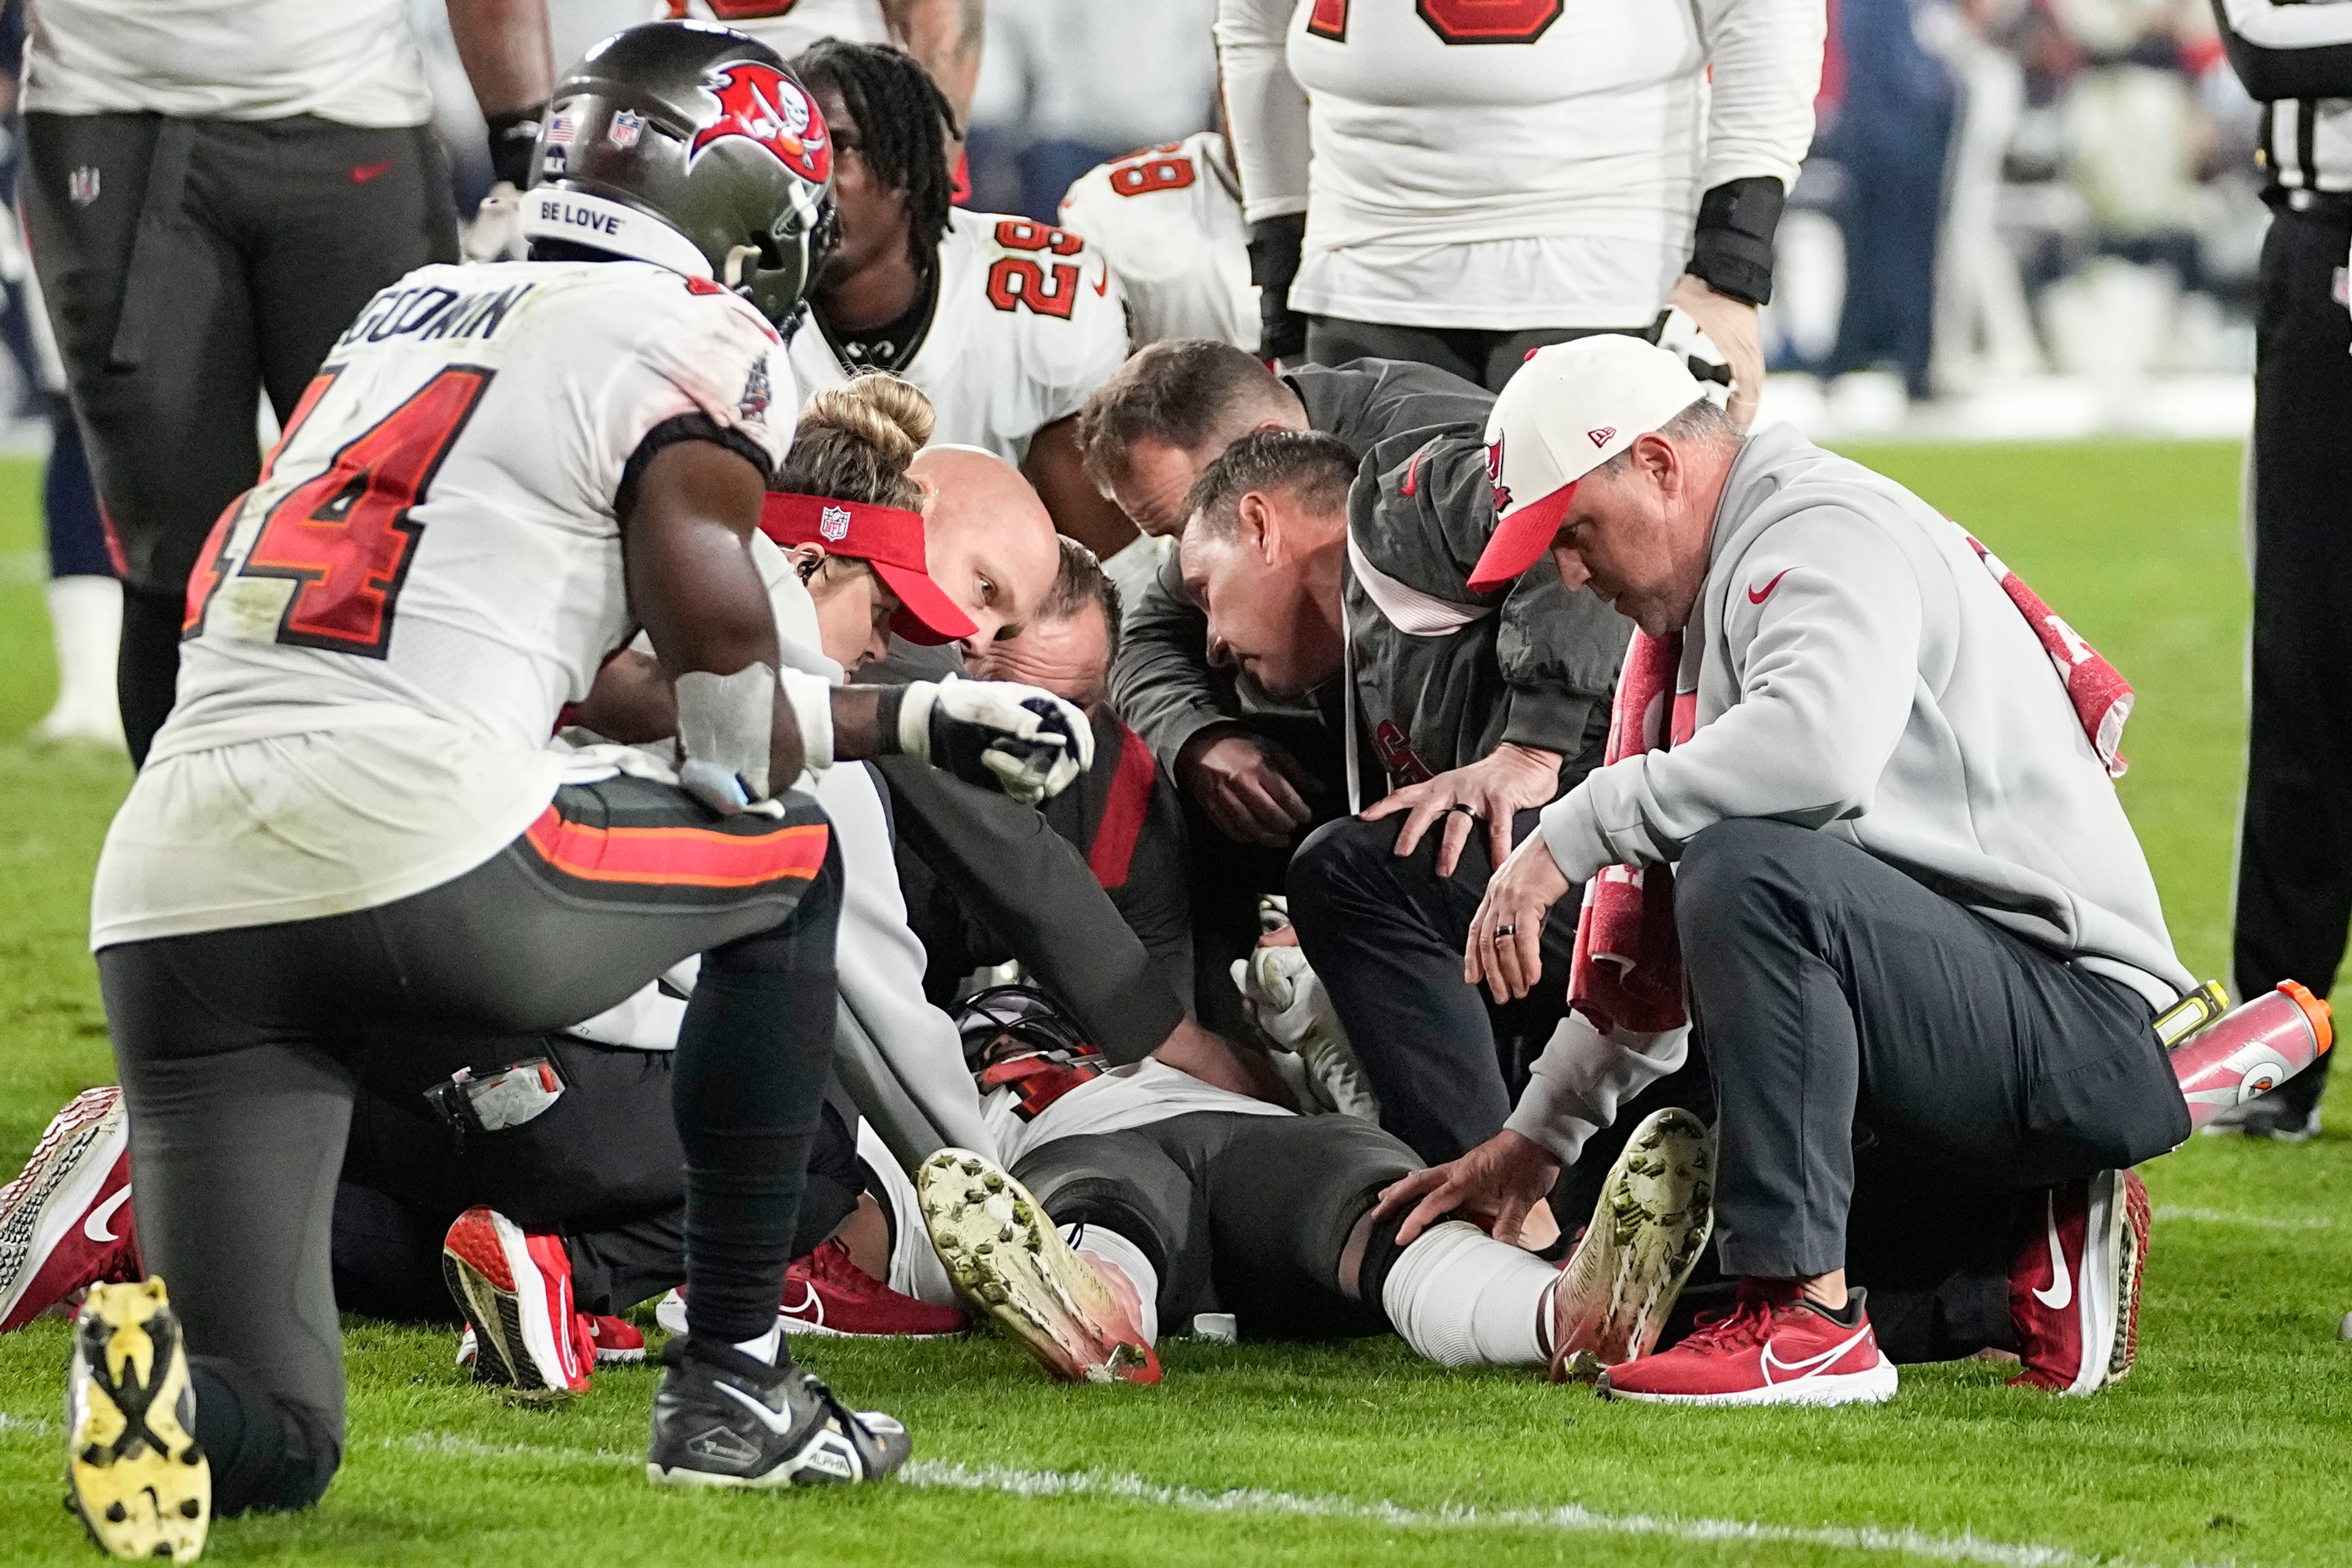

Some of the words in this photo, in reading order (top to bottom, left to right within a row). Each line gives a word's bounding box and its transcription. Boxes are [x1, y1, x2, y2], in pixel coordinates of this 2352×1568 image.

[541, 201, 561, 221] BE
[565, 205, 621, 236] LOVE
[986, 221, 1085, 321] 29
[824, 520, 843, 536] NFL
[808, 1452, 850, 1472] ALPHA
